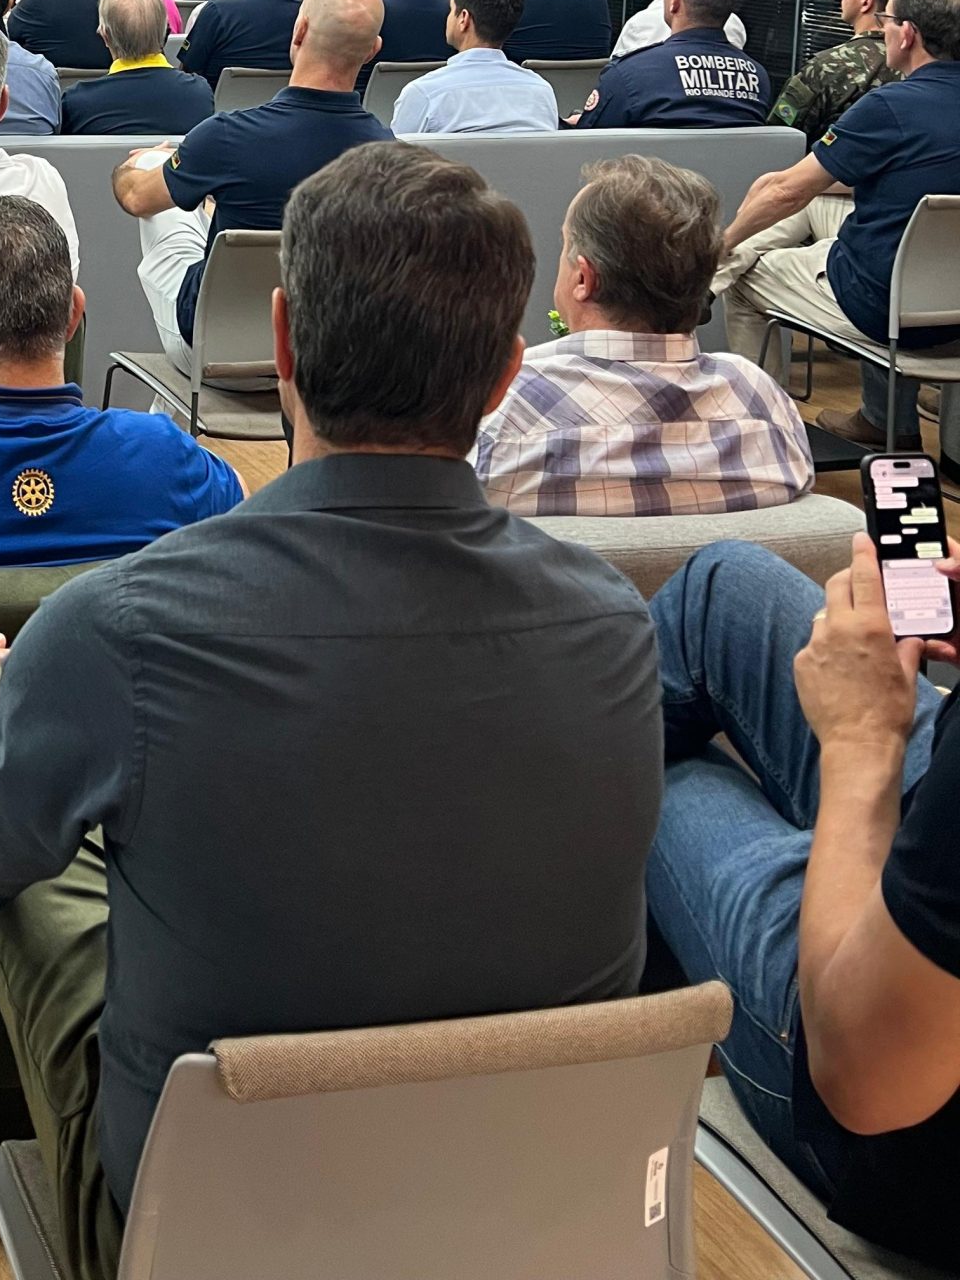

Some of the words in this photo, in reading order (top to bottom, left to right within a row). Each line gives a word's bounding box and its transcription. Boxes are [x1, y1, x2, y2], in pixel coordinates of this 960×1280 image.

[674, 54, 757, 74] BOMBEIRO
[679, 69, 760, 94] MILITAR
[684, 88, 701, 97] RIO
[702, 88, 735, 99] GRANDE
[736, 90, 748, 99] DO
